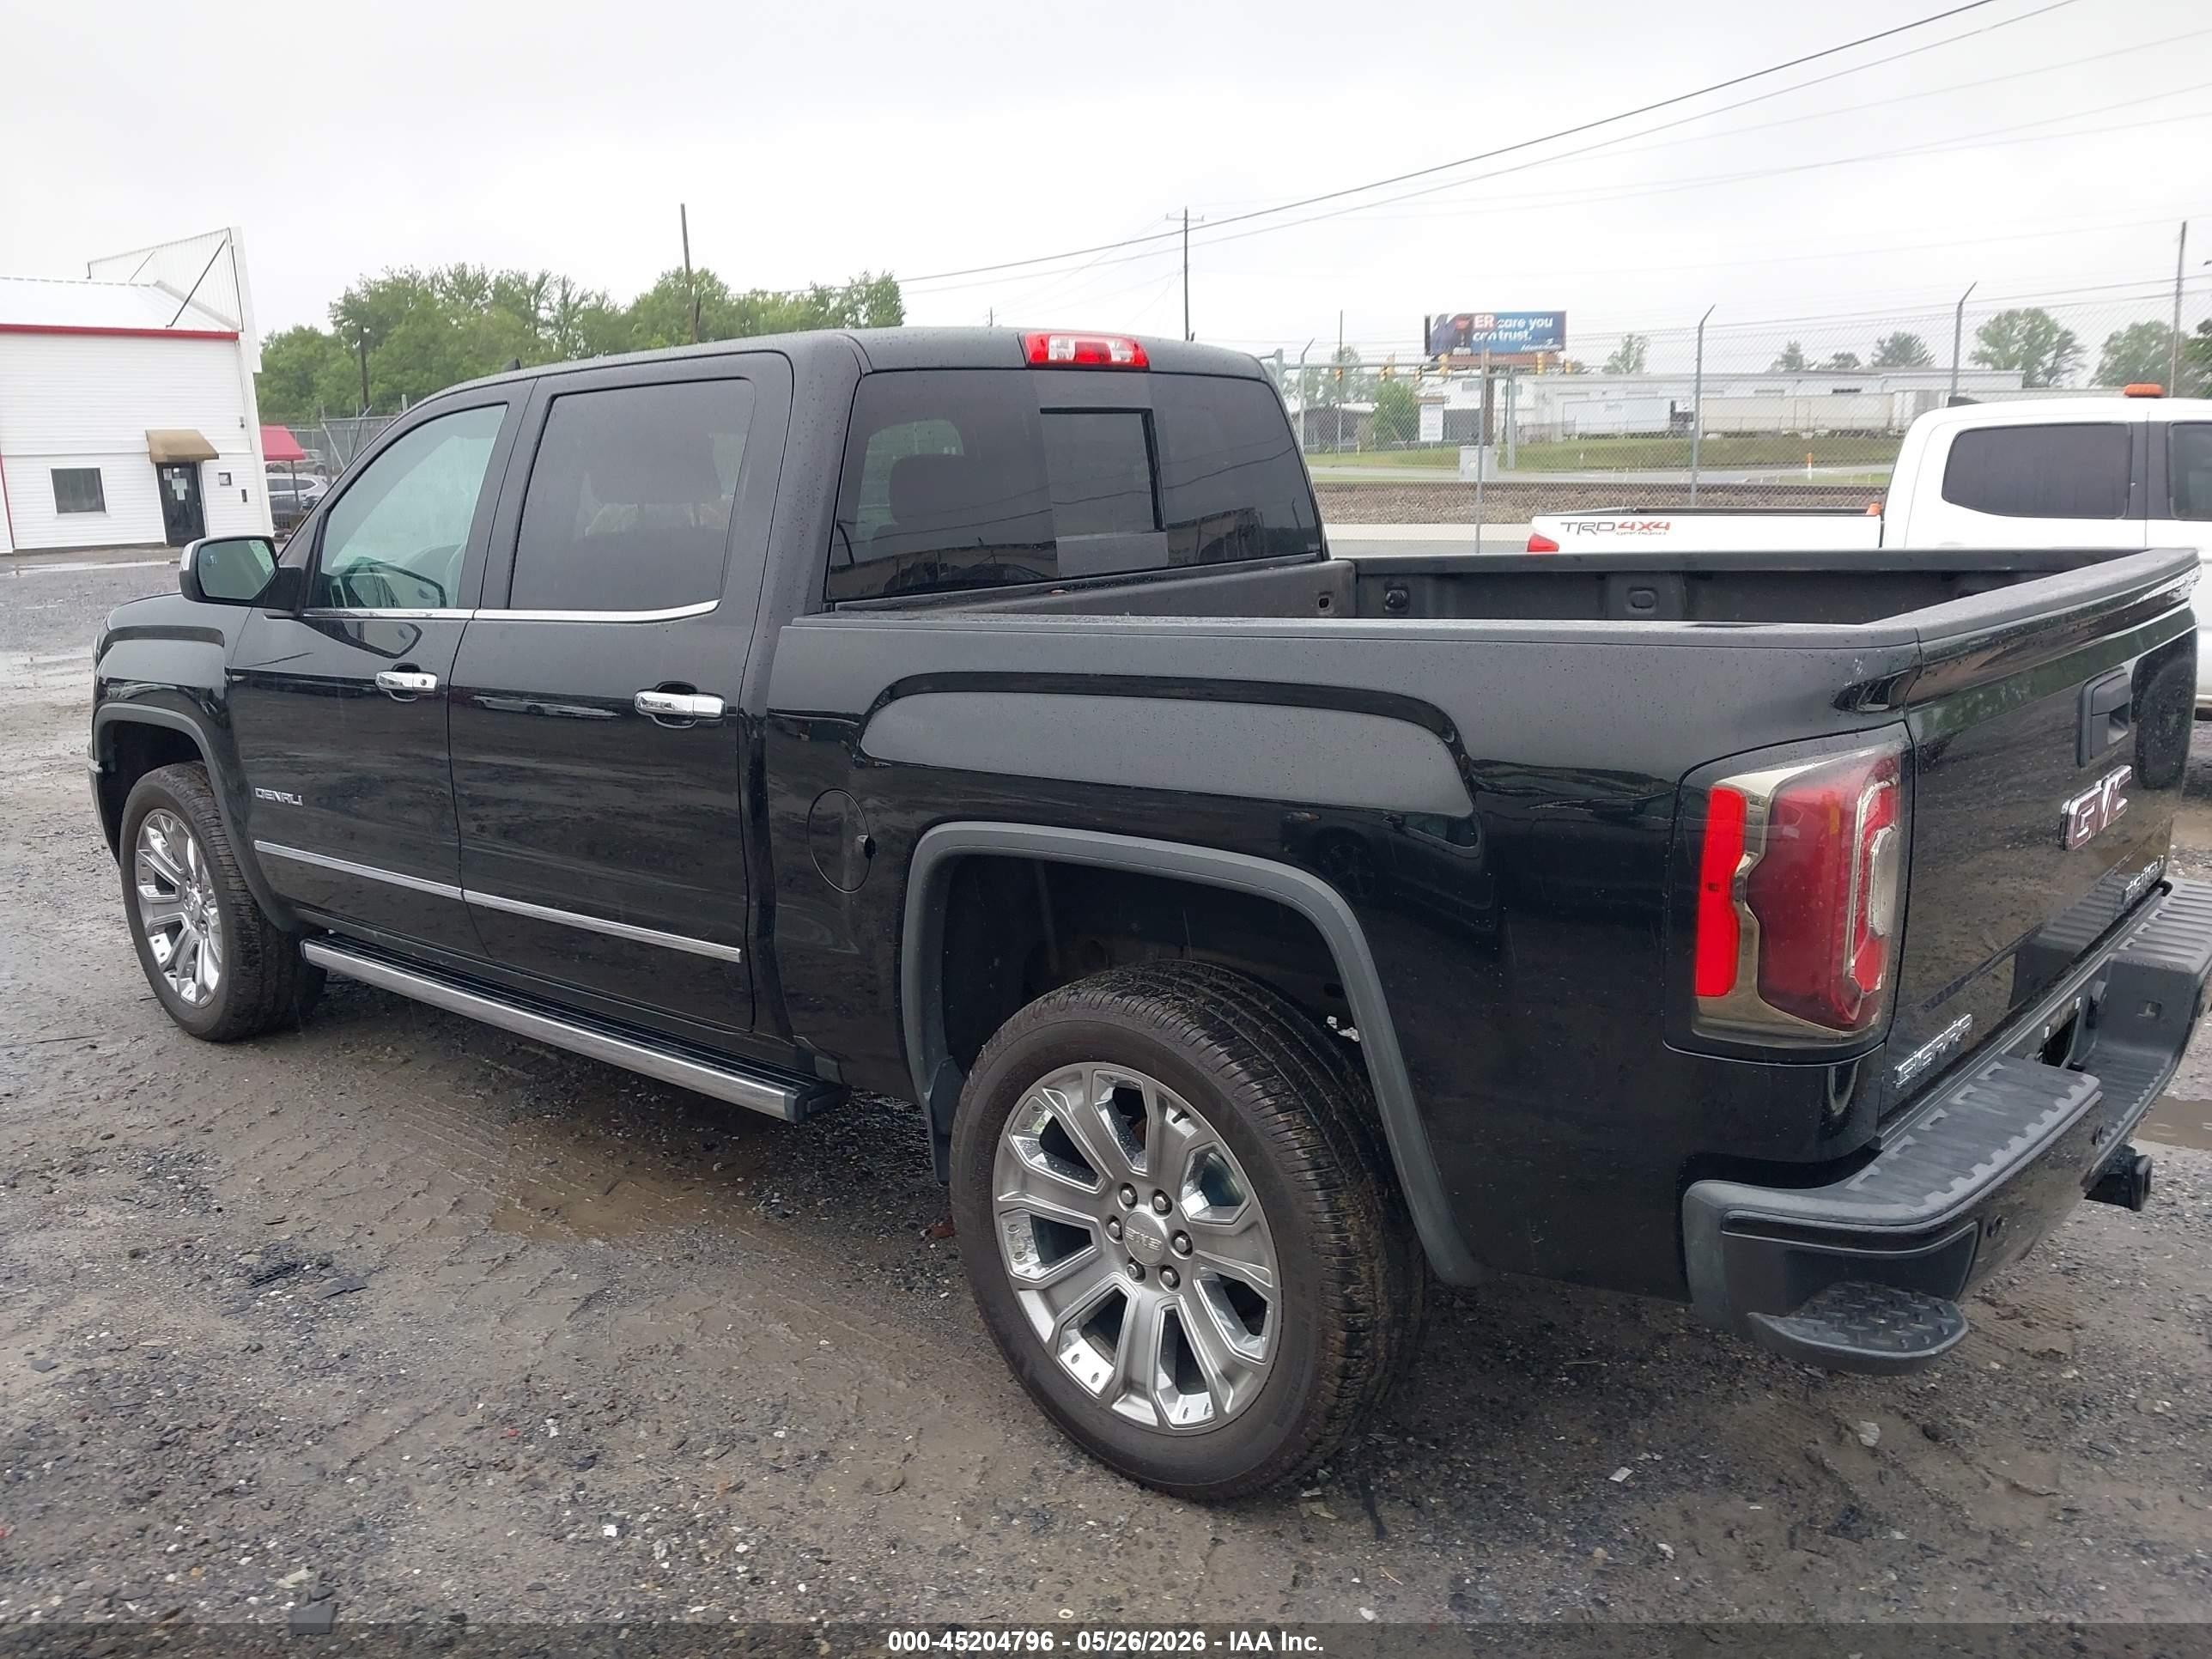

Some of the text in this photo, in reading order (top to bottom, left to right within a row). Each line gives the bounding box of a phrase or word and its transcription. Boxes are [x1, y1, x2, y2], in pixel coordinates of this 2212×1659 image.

[1474, 314, 1553, 331] ER care you
[1473, 329, 1532, 342] can trust.
[1560, 521, 1615, 535] TRD
[254, 787, 302, 806] DENALI
[2060, 764, 2133, 851] GMC
[1894, 1013, 1973, 1089] SIERRA
